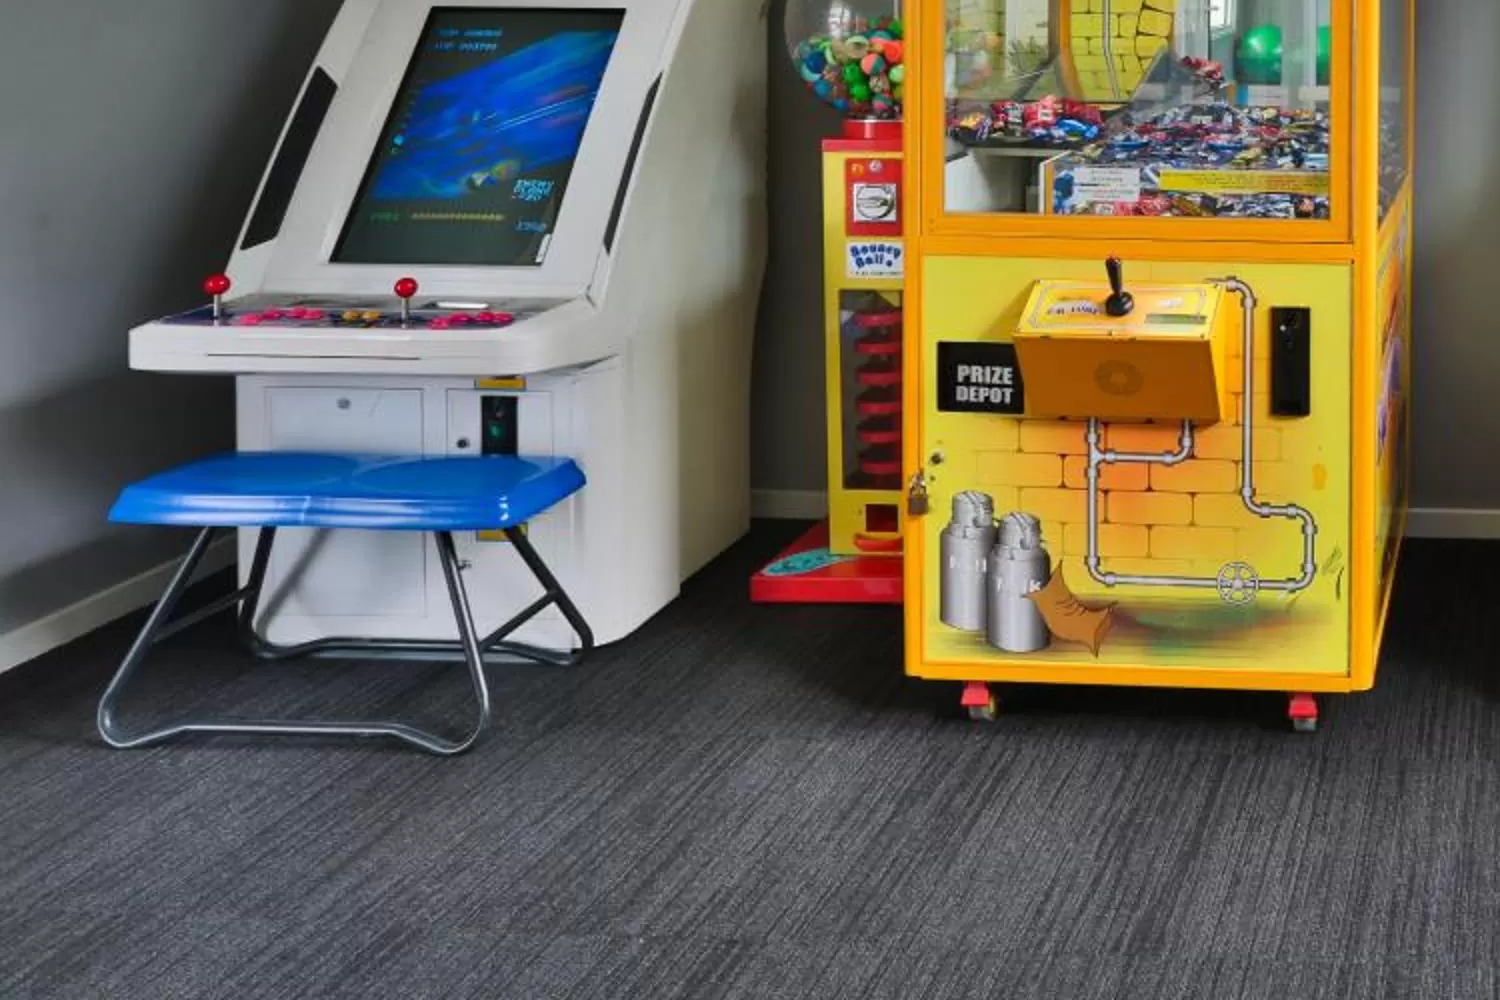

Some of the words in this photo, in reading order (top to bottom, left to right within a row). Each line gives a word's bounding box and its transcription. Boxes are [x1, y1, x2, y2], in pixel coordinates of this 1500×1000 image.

[850, 244, 901, 260] Bouncy
[957, 364, 1014, 385] PRIZE
[955, 385, 1015, 405] DEPOT
